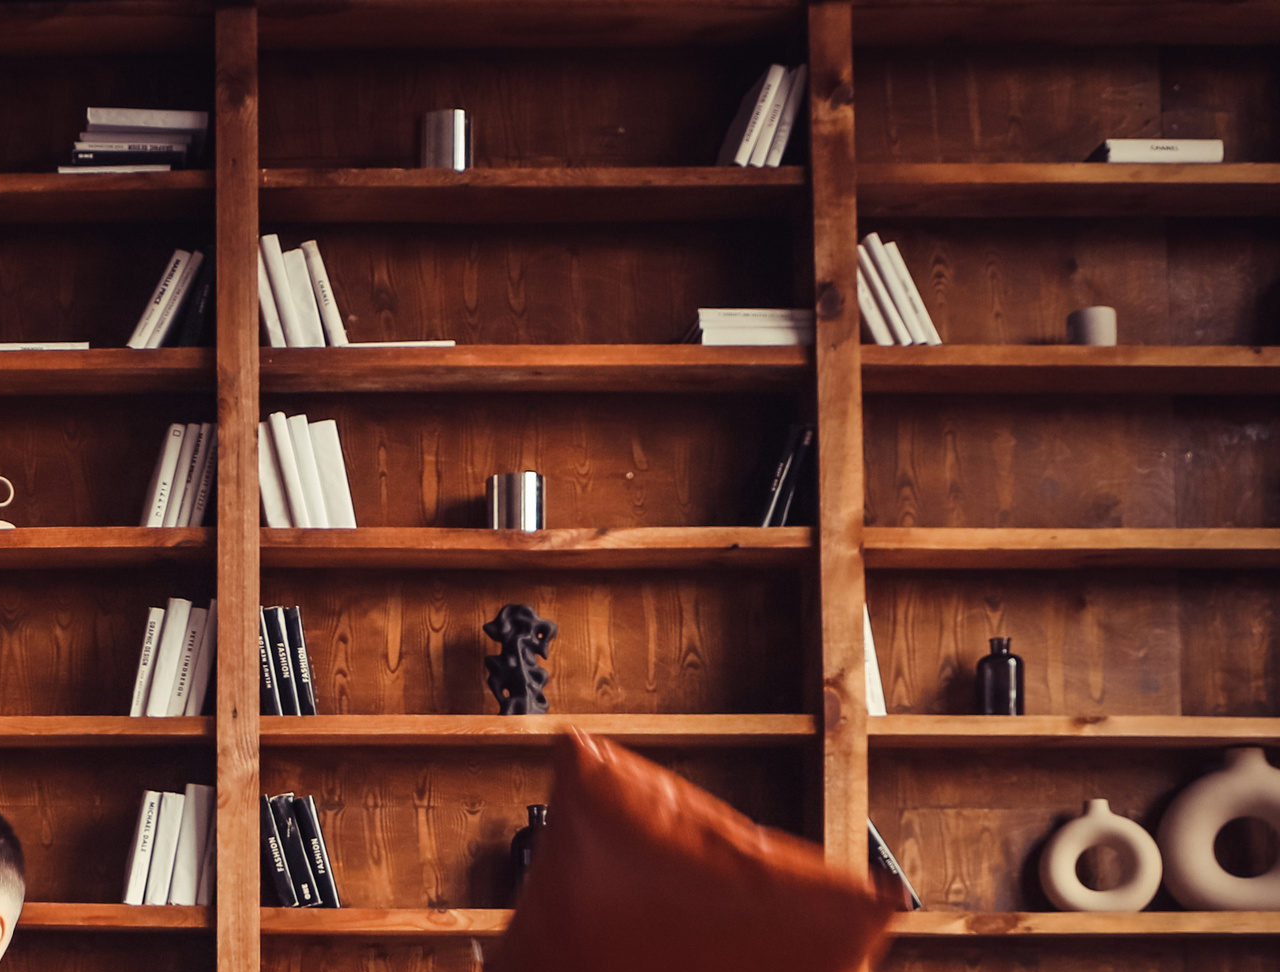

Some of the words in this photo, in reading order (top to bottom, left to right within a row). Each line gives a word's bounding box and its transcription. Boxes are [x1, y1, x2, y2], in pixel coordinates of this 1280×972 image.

[162, 258, 181, 287] MARIELLE
[153, 287, 166, 306] PRICE
[145, 621, 156, 645] GRAPHIC
[187, 630, 197, 652] PETER
[142, 645, 151, 666] DESIGN
[276, 642, 290, 679] FASHION
[297, 646, 310, 684] FASHION
[177, 655, 191, 698] LINDBERGH
[263, 664, 272, 689] HELMUT
[144, 801, 156, 832] MICHAEL
[140, 834, 149, 852] DALE
[268, 836, 285, 873] FASHION
[310, 837, 325, 874] FASHION
[301, 882, 311, 901] ONE
